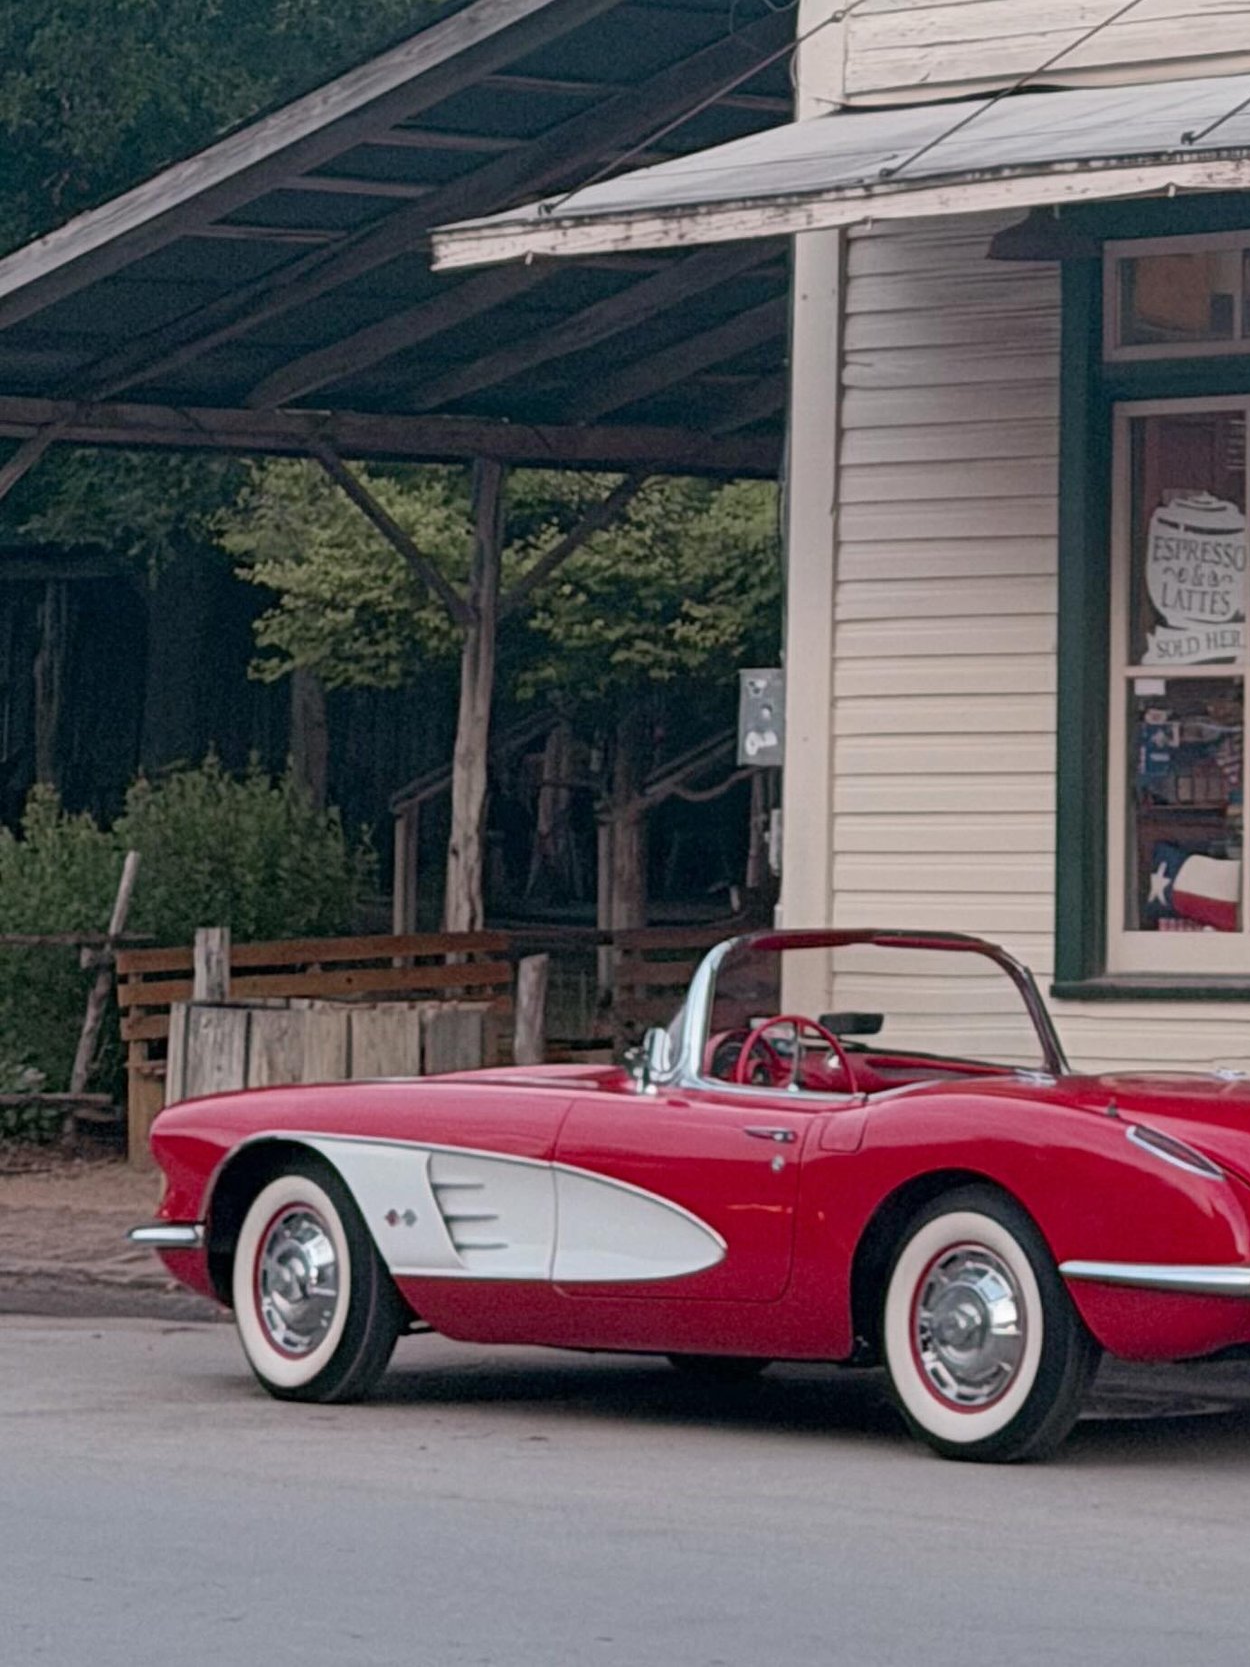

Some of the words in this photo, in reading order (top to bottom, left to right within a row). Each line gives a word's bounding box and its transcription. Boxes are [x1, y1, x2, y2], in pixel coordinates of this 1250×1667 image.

[1153, 535, 1246, 572] ESPRESSO
[1161, 581, 1231, 615] LATTES
[1156, 636, 1200, 659] SOLD
[1206, 629, 1247, 651] HER
